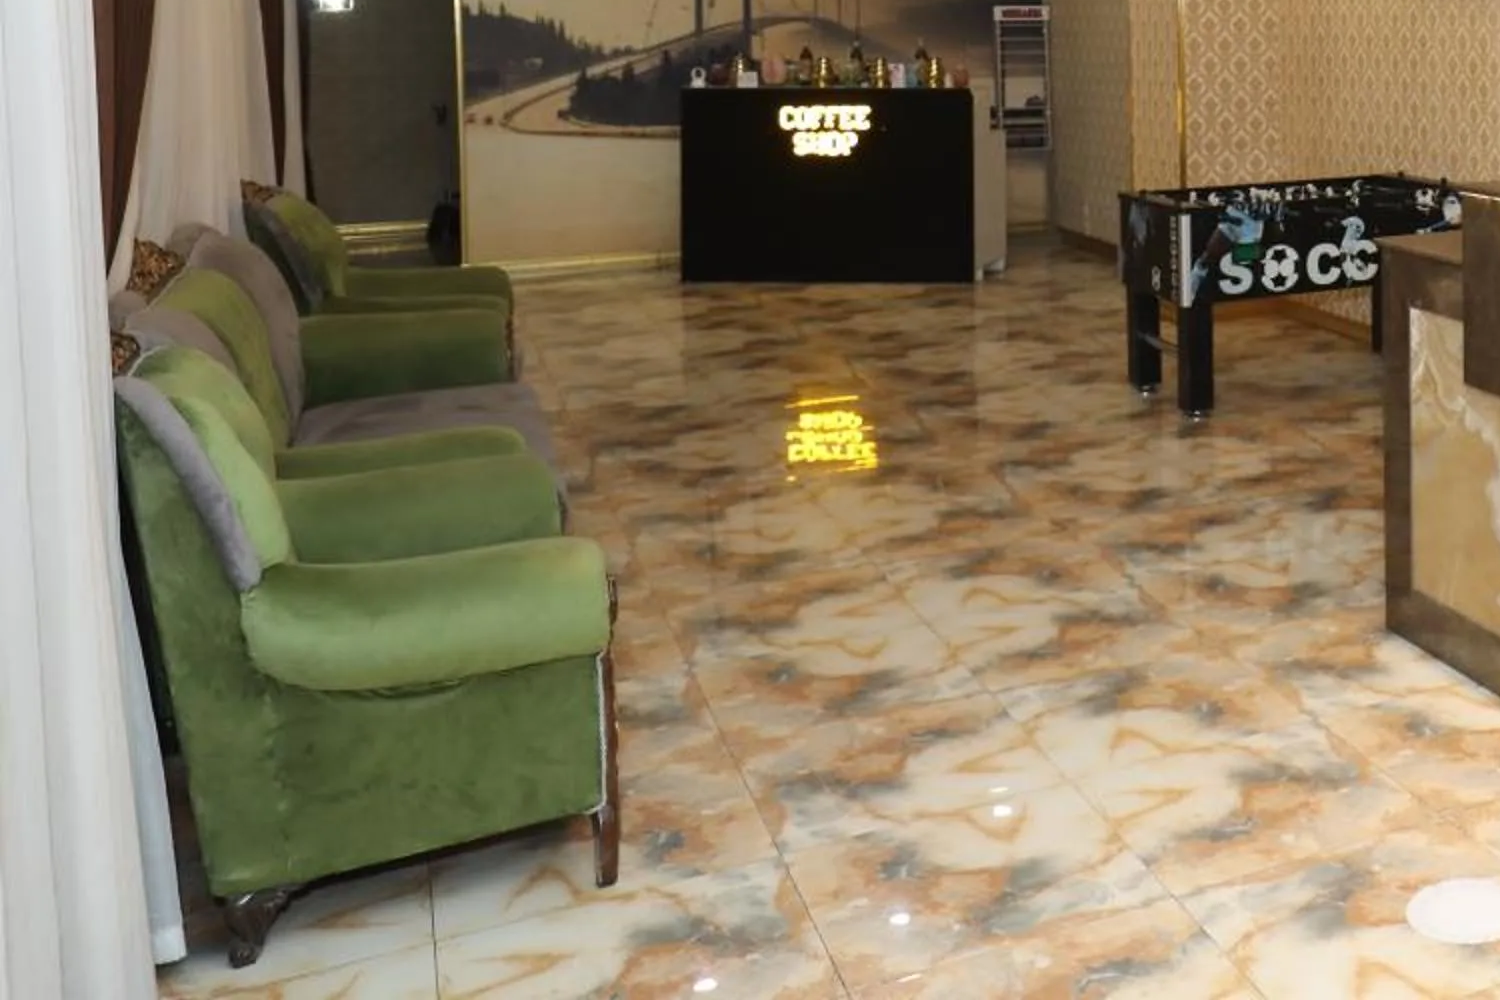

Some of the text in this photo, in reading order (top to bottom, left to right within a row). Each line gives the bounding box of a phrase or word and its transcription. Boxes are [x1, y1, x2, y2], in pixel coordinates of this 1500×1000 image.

[779, 105, 871, 131] COFFEE
[793, 131, 858, 156] SHOP
[1218, 243, 1379, 295] SOCC
